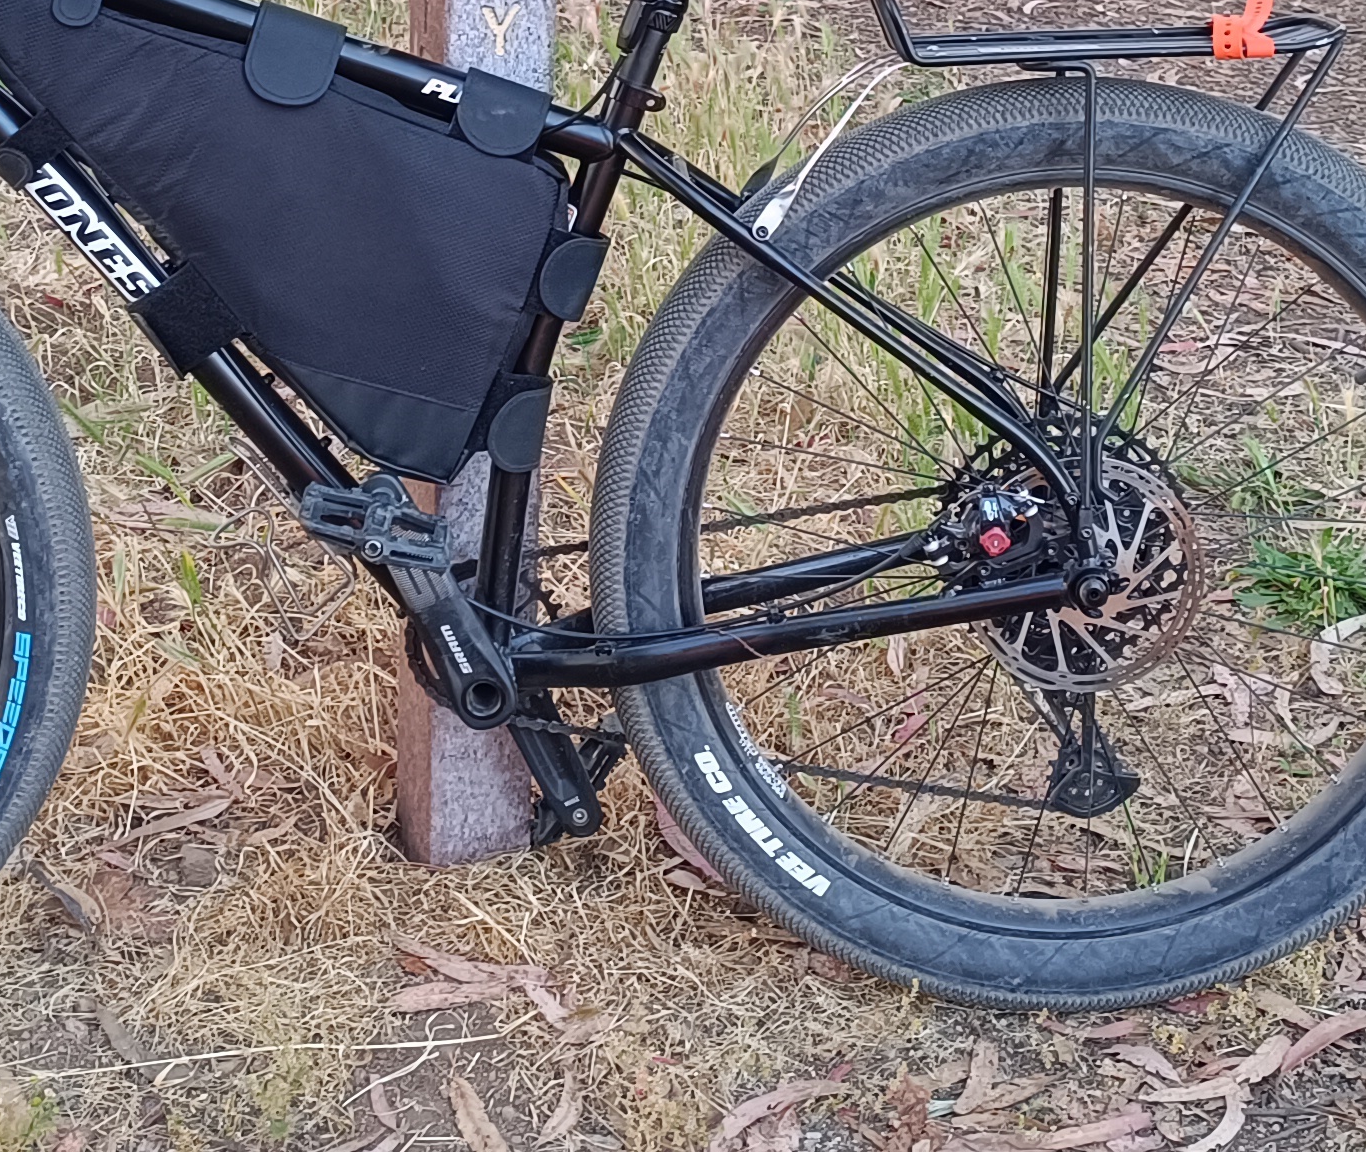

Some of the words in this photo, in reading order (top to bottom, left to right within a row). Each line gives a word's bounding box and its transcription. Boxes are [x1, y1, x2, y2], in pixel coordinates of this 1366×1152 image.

[440, 624, 473, 674] SRAM
[722, 795, 784, 858] TIRE
[775, 851, 831, 897] VEE
